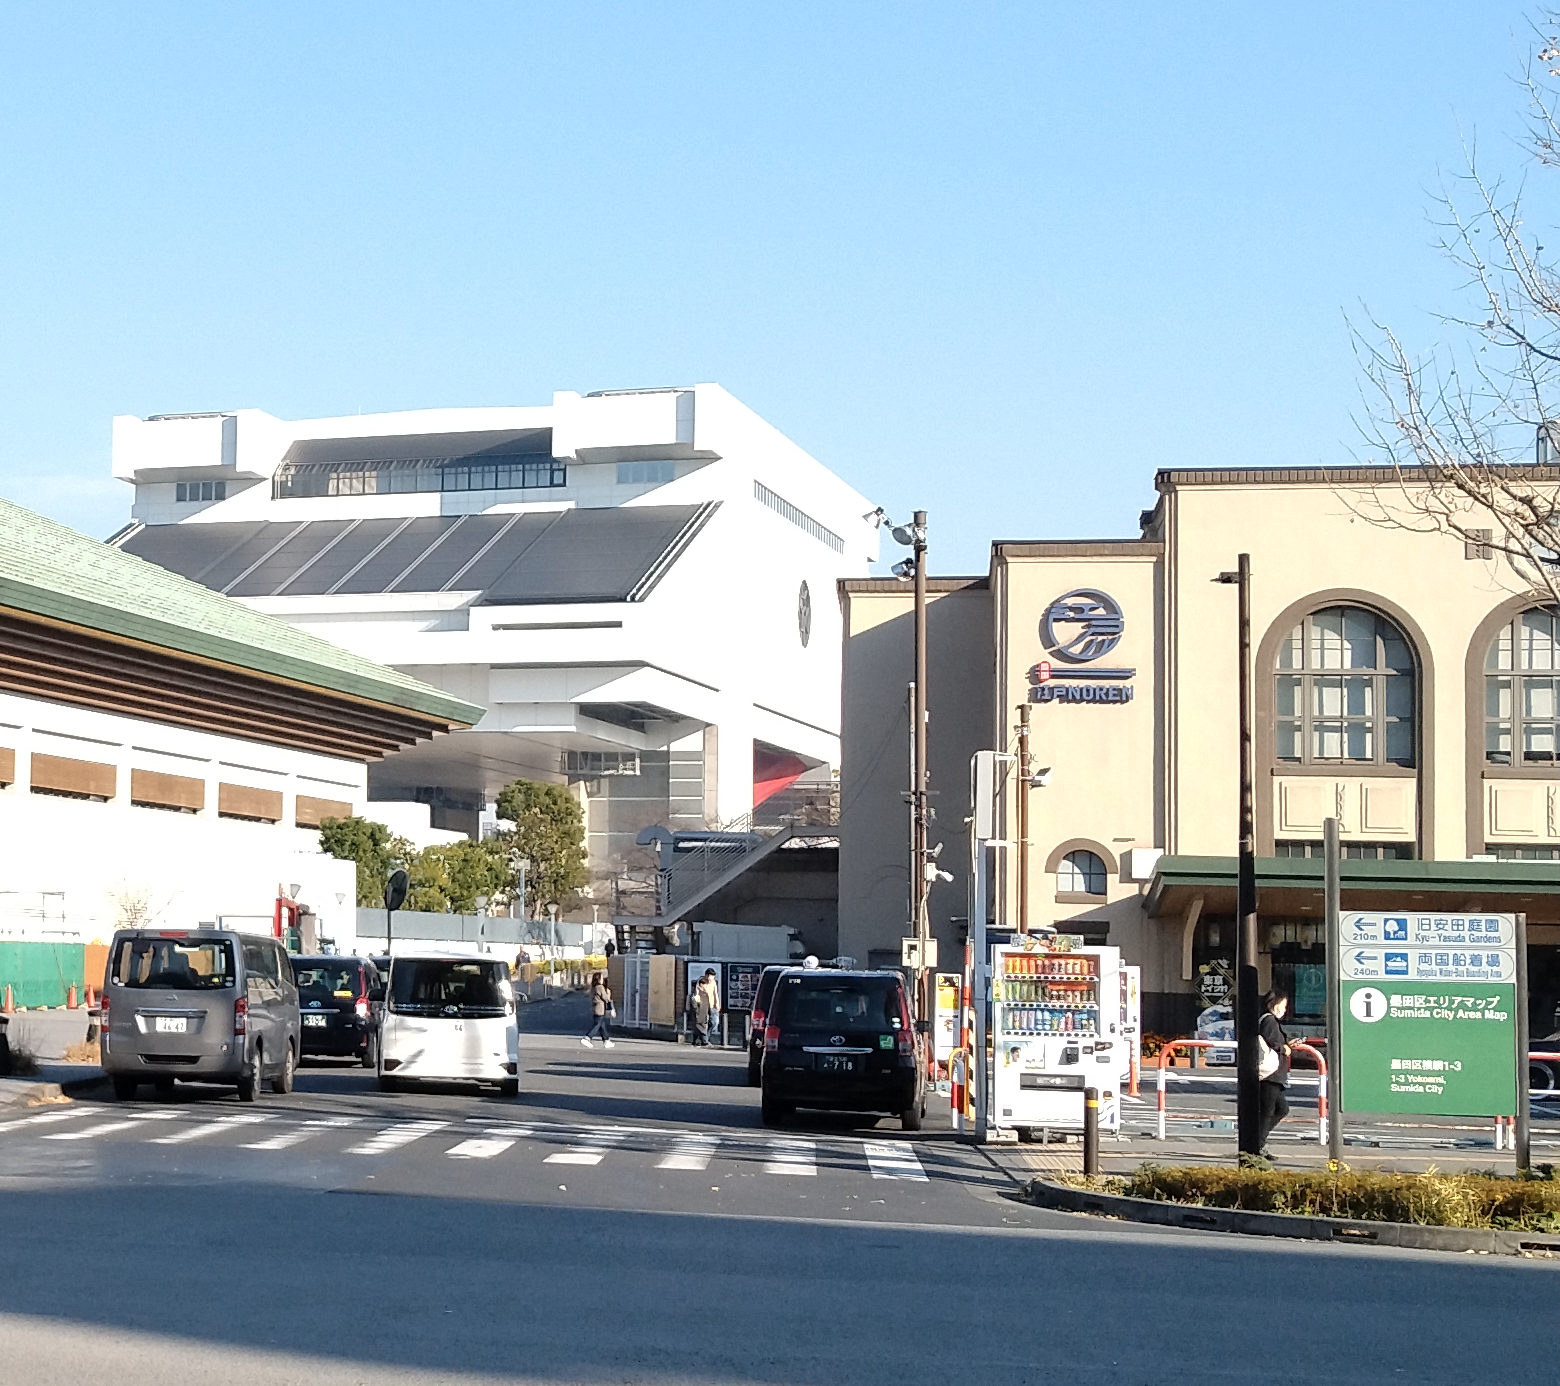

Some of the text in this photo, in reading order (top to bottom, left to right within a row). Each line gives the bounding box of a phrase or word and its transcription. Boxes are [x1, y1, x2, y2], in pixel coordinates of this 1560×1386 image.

[1416, 918, 1499, 933] 旧安田庭園
[1352, 933, 1378, 941] 210m
[1468, 933, 1502, 943] Gardens
[1418, 952, 1501, 967] 両国船着場
[1353, 968, 1379, 976] 240m
[1389, 1008, 1508, 1021] Sumida City Area Map
[1390, 1083, 1443, 1095] Sumida City
